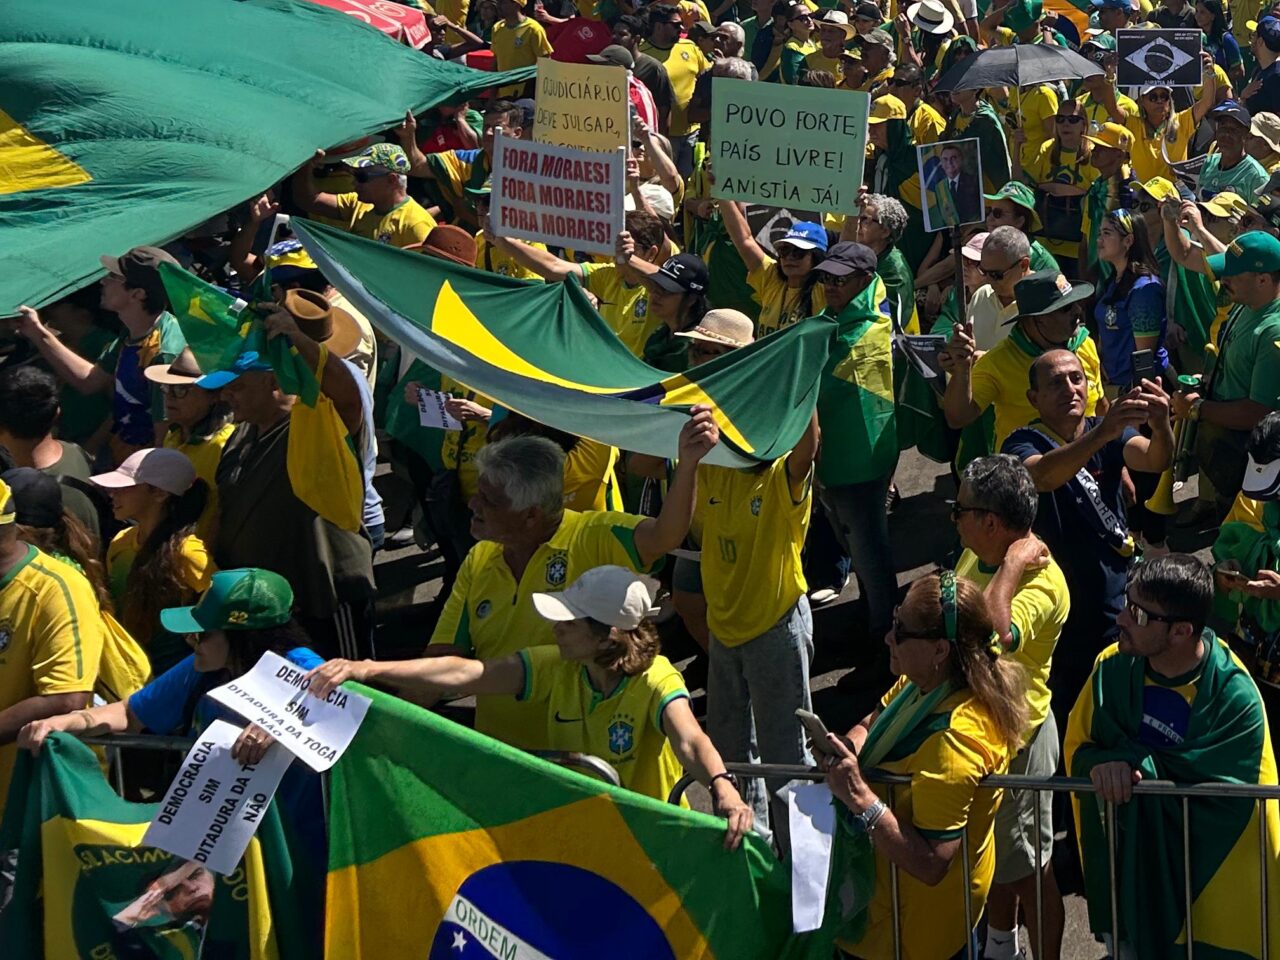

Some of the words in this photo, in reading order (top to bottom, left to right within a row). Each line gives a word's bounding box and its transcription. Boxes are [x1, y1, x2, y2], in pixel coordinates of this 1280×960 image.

[536, 107, 557, 129] DEVE
[725, 102, 786, 128] POVO
[795, 110, 858, 140] FORTE,
[502, 146, 538, 174] FORA
[540, 154, 611, 185] MORAES!
[720, 138, 762, 162] PAÍS
[775, 143, 844, 173] LIVRE!
[501, 176, 537, 204] FORA
[539, 184, 611, 215] MORAES!
[721, 175, 801, 203] ANISTIA
[810, 183, 840, 211] JÁ!
[500, 206, 539, 233] FORA
[541, 214, 611, 245] MORAES!
[227, 609, 249, 625] 22
[226, 683, 285, 728] DITADURA
[284, 725, 304, 740] DA
[302, 736, 338, 763] TOGA
[256, 717, 283, 738] NÃO
[284, 700, 310, 722] SIM
[158, 740, 216, 826] DEMOCRACIA
[198, 777, 222, 804] SIM
[193, 796, 240, 863] DITADURA
[230, 776, 252, 796] DA
[242, 792, 268, 824] NÃO
[455, 898, 518, 960] ORDEM
